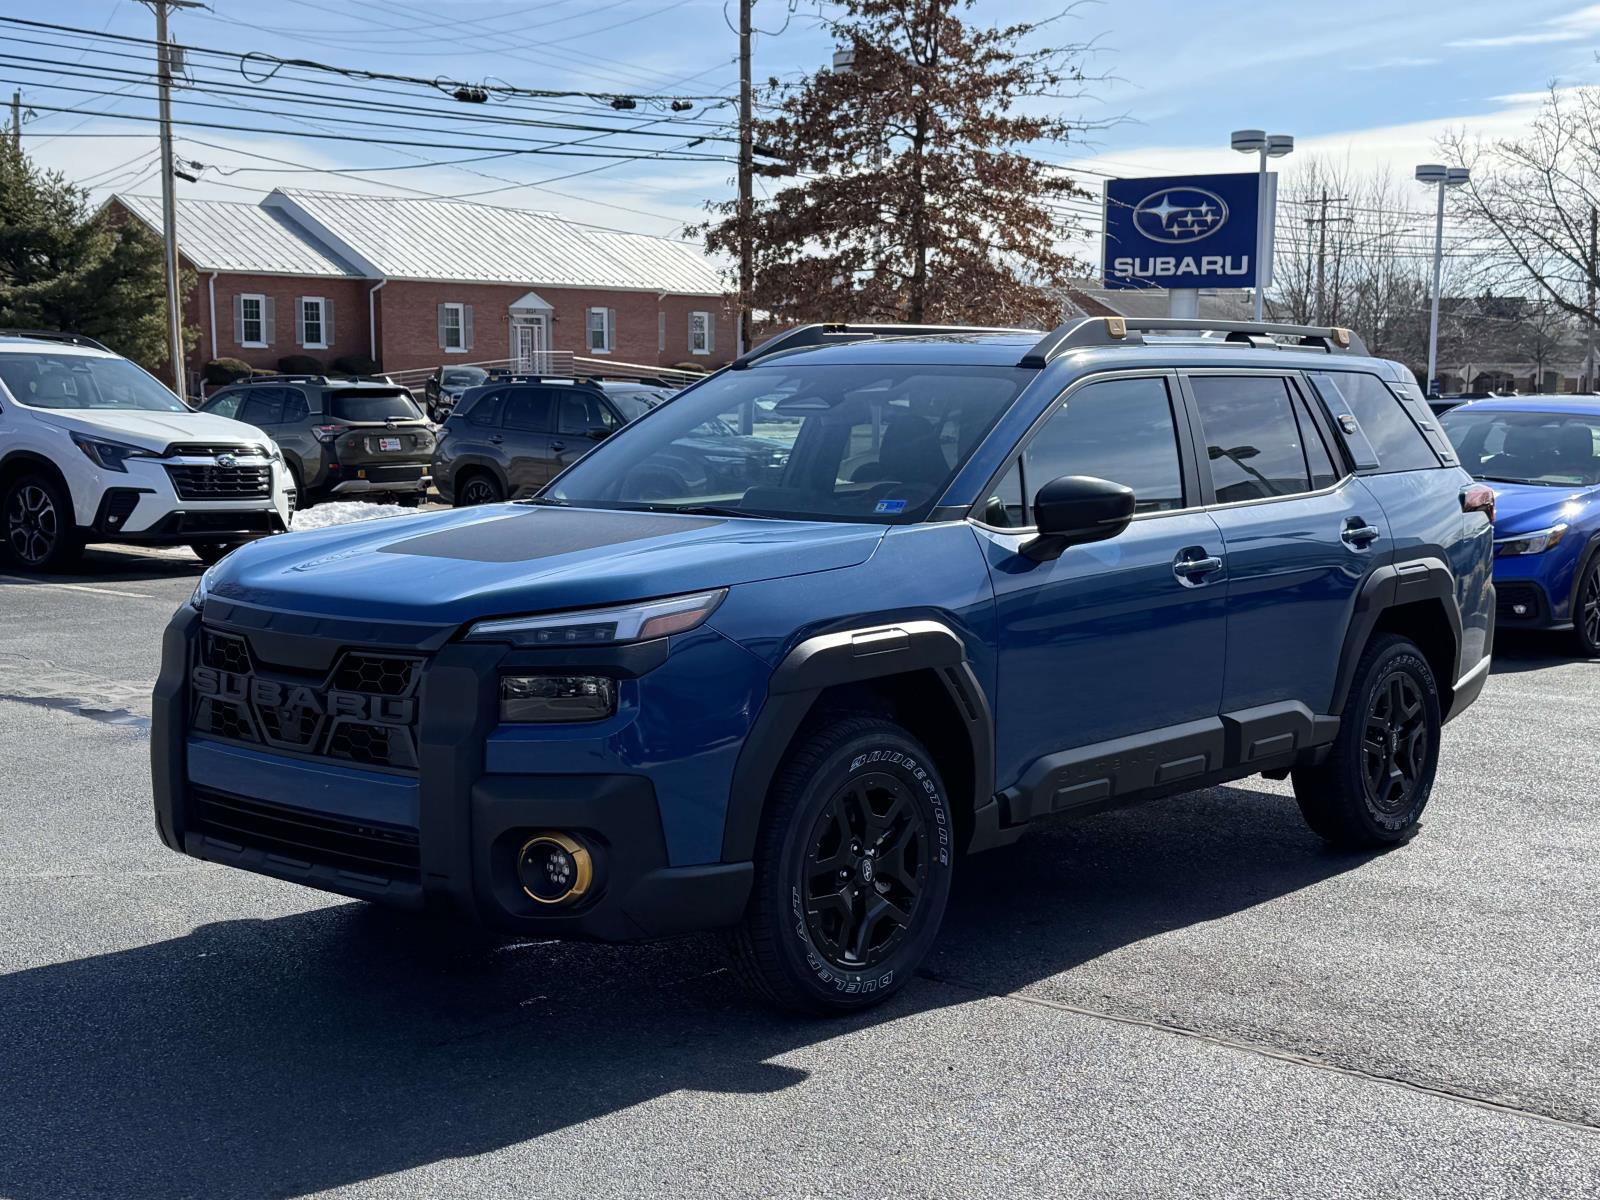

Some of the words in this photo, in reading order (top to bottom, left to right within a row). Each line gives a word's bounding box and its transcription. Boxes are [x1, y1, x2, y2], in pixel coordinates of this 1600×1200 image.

[1114, 256, 1249, 277] SUBARU
[192, 666, 414, 724] SUBARU
[849, 751, 948, 866] BRIDGESTONE
[807, 953, 894, 993] DUELER
